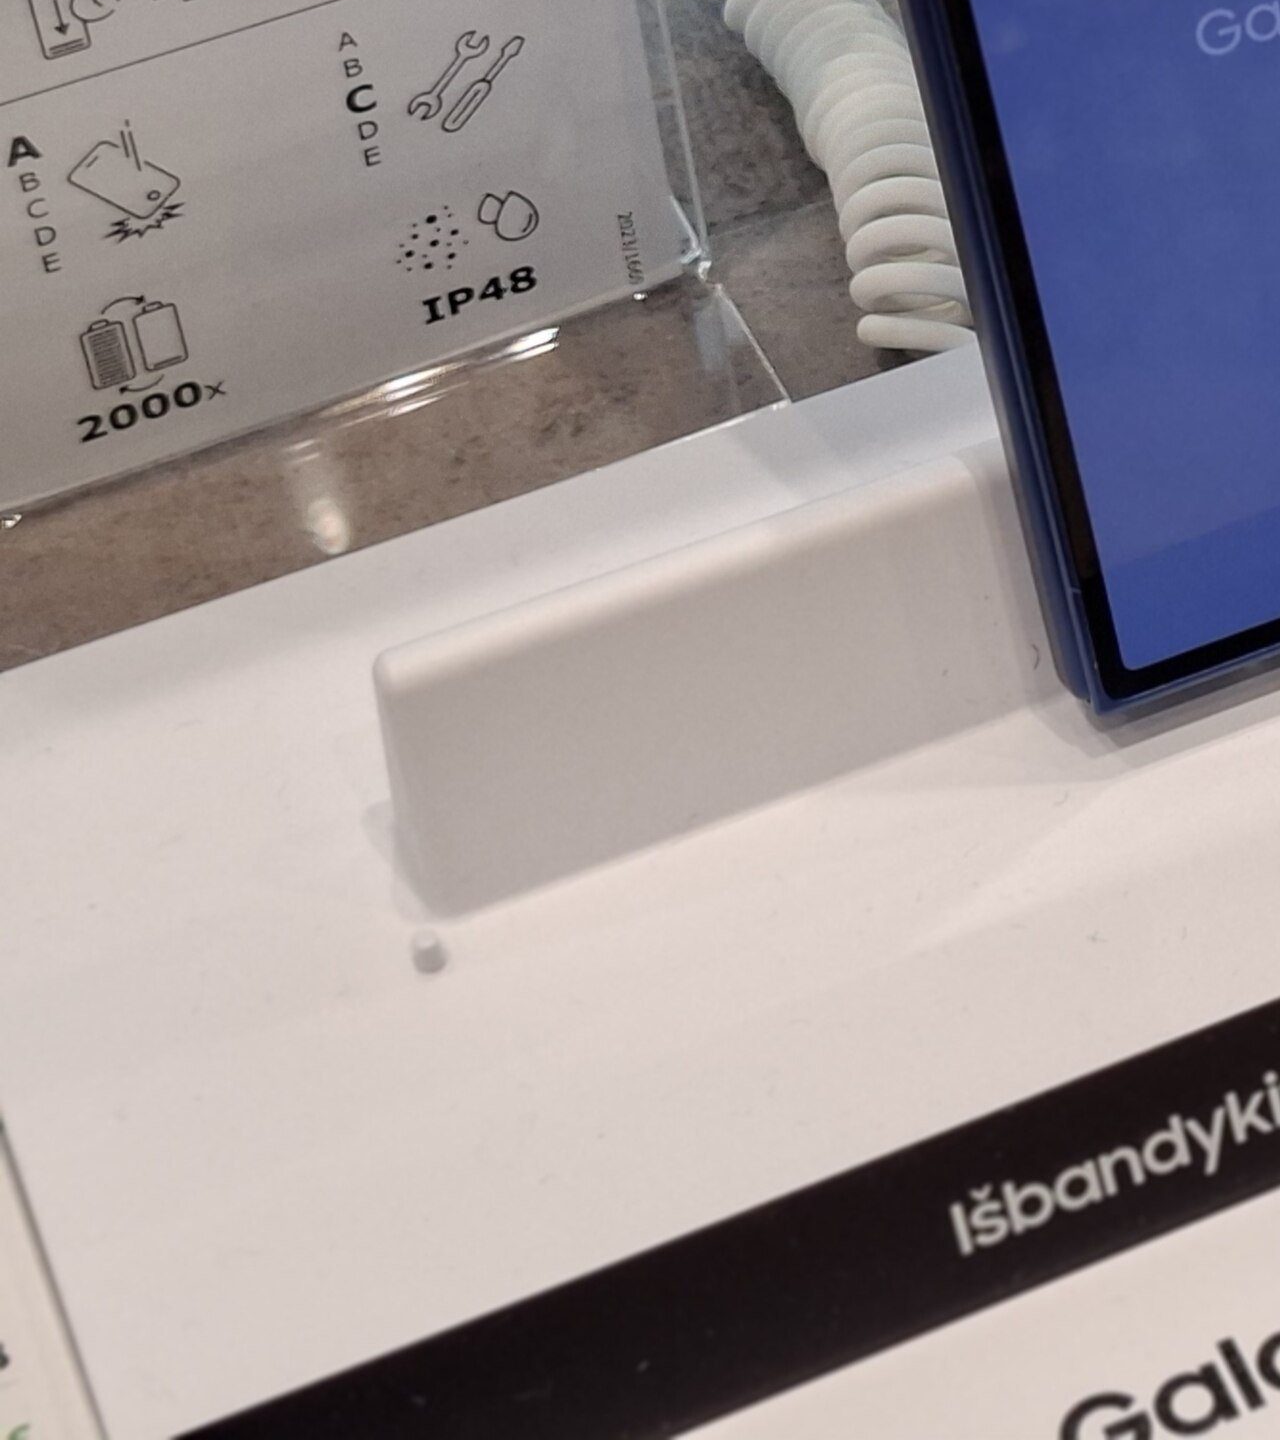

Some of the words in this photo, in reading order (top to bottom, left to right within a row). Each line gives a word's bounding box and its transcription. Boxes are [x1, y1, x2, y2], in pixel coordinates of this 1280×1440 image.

[338, 32, 360, 51] A
[343, 58, 363, 77] B
[346, 85, 377, 114] C
[357, 121, 379, 140] D
[6, 135, 43, 165] A
[363, 147, 381, 168] E
[18, 172, 41, 192] B
[25, 198, 47, 220] C
[34, 226, 57, 247] D
[42, 253, 63, 274] E
[421, 265, 538, 325] IP48
